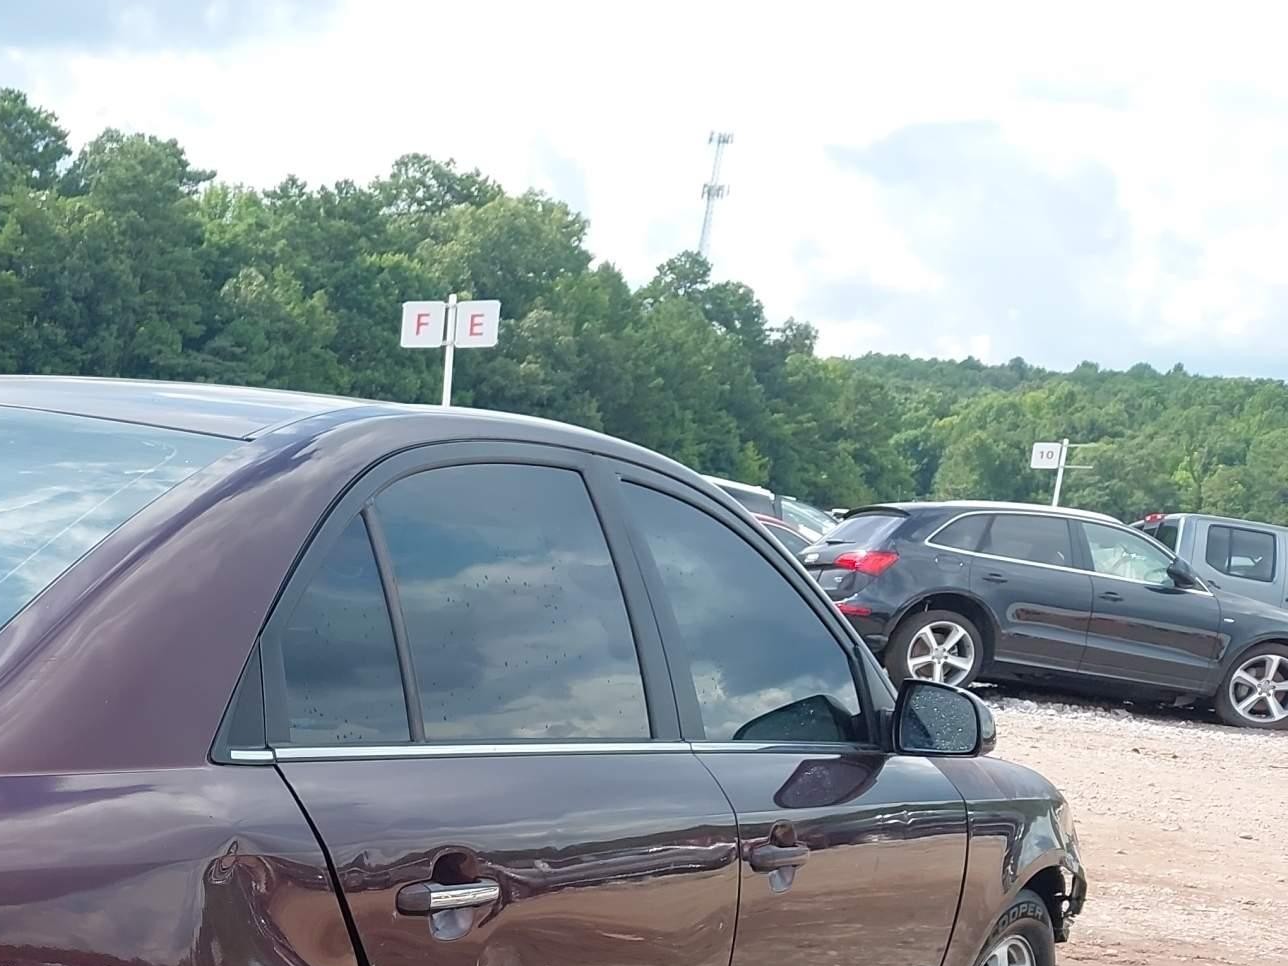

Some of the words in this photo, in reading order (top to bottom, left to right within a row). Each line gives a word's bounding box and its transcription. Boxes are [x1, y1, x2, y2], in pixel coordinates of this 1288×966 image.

[415, 313, 430, 336] F
[469, 313, 485, 336] E
[1039, 450, 1054, 460] 10
